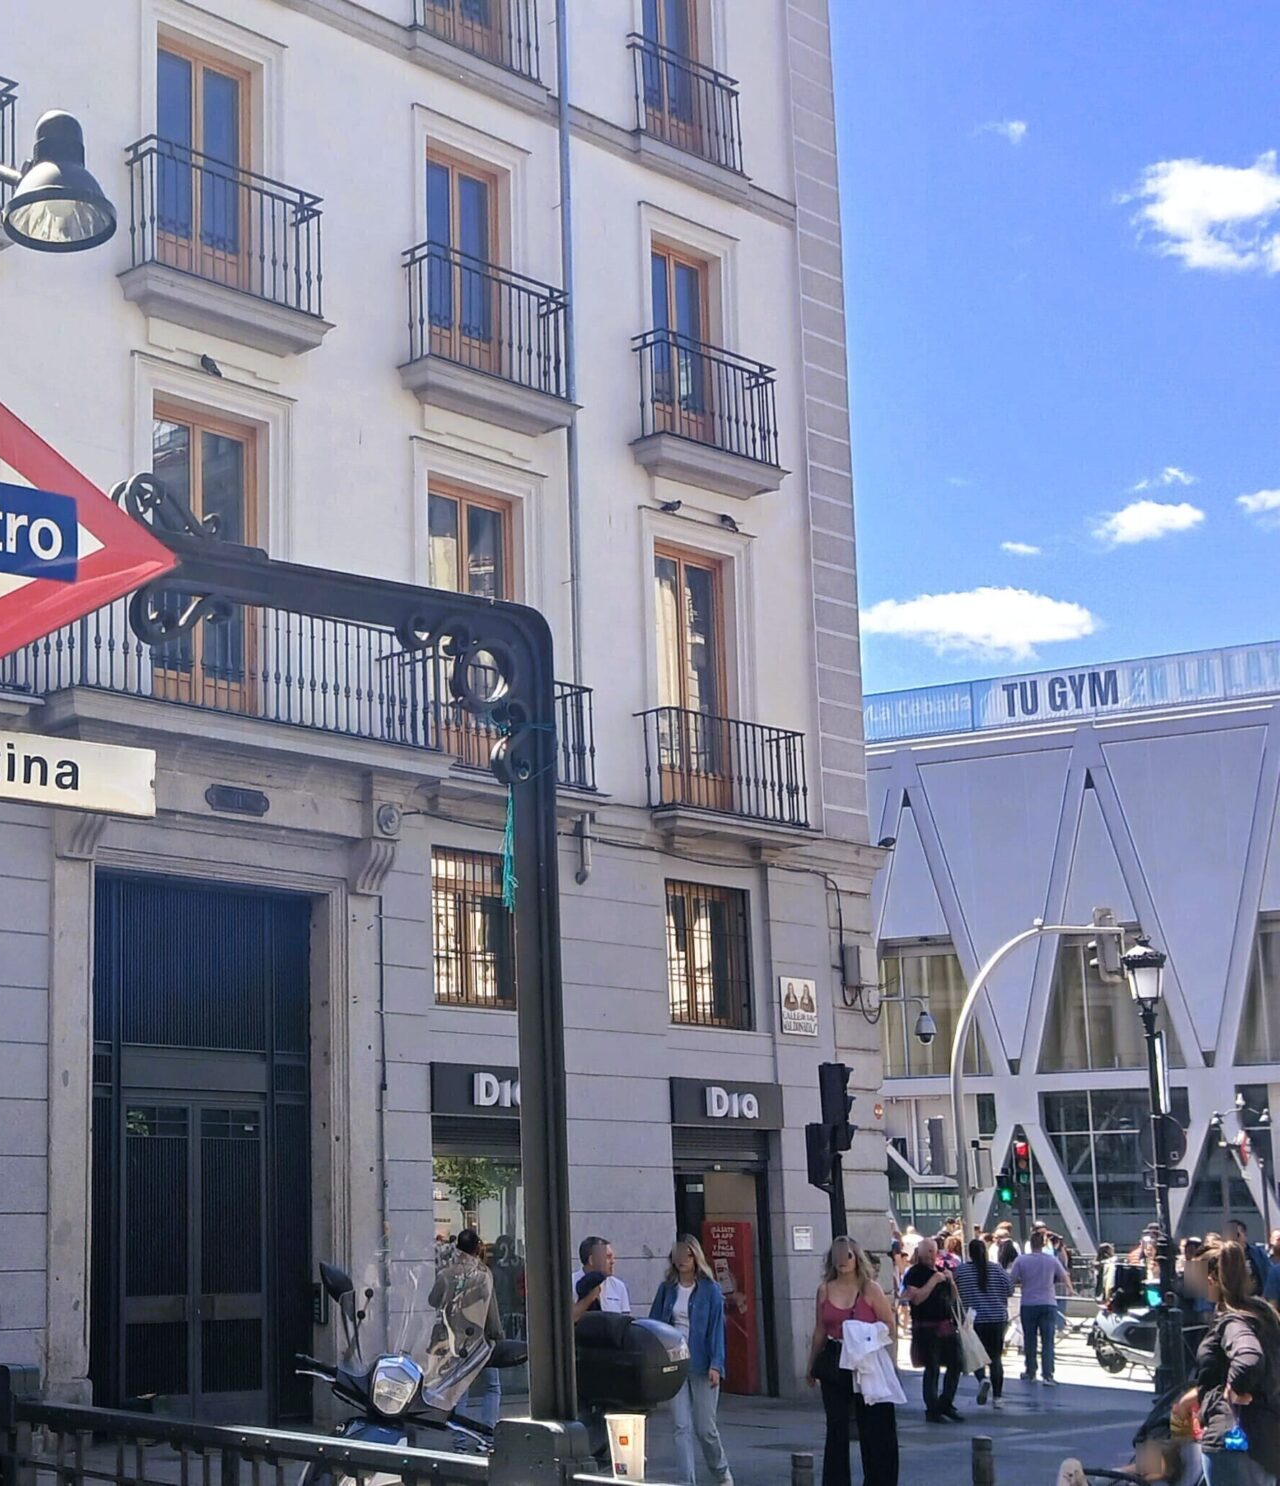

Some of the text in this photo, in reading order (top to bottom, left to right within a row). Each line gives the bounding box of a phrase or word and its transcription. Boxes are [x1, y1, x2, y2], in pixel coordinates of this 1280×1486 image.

[1002, 680, 1039, 718] TU
[1047, 669, 1119, 712] GYM
[474, 1072, 520, 1108] Di
[706, 1086, 759, 1119] Dia
